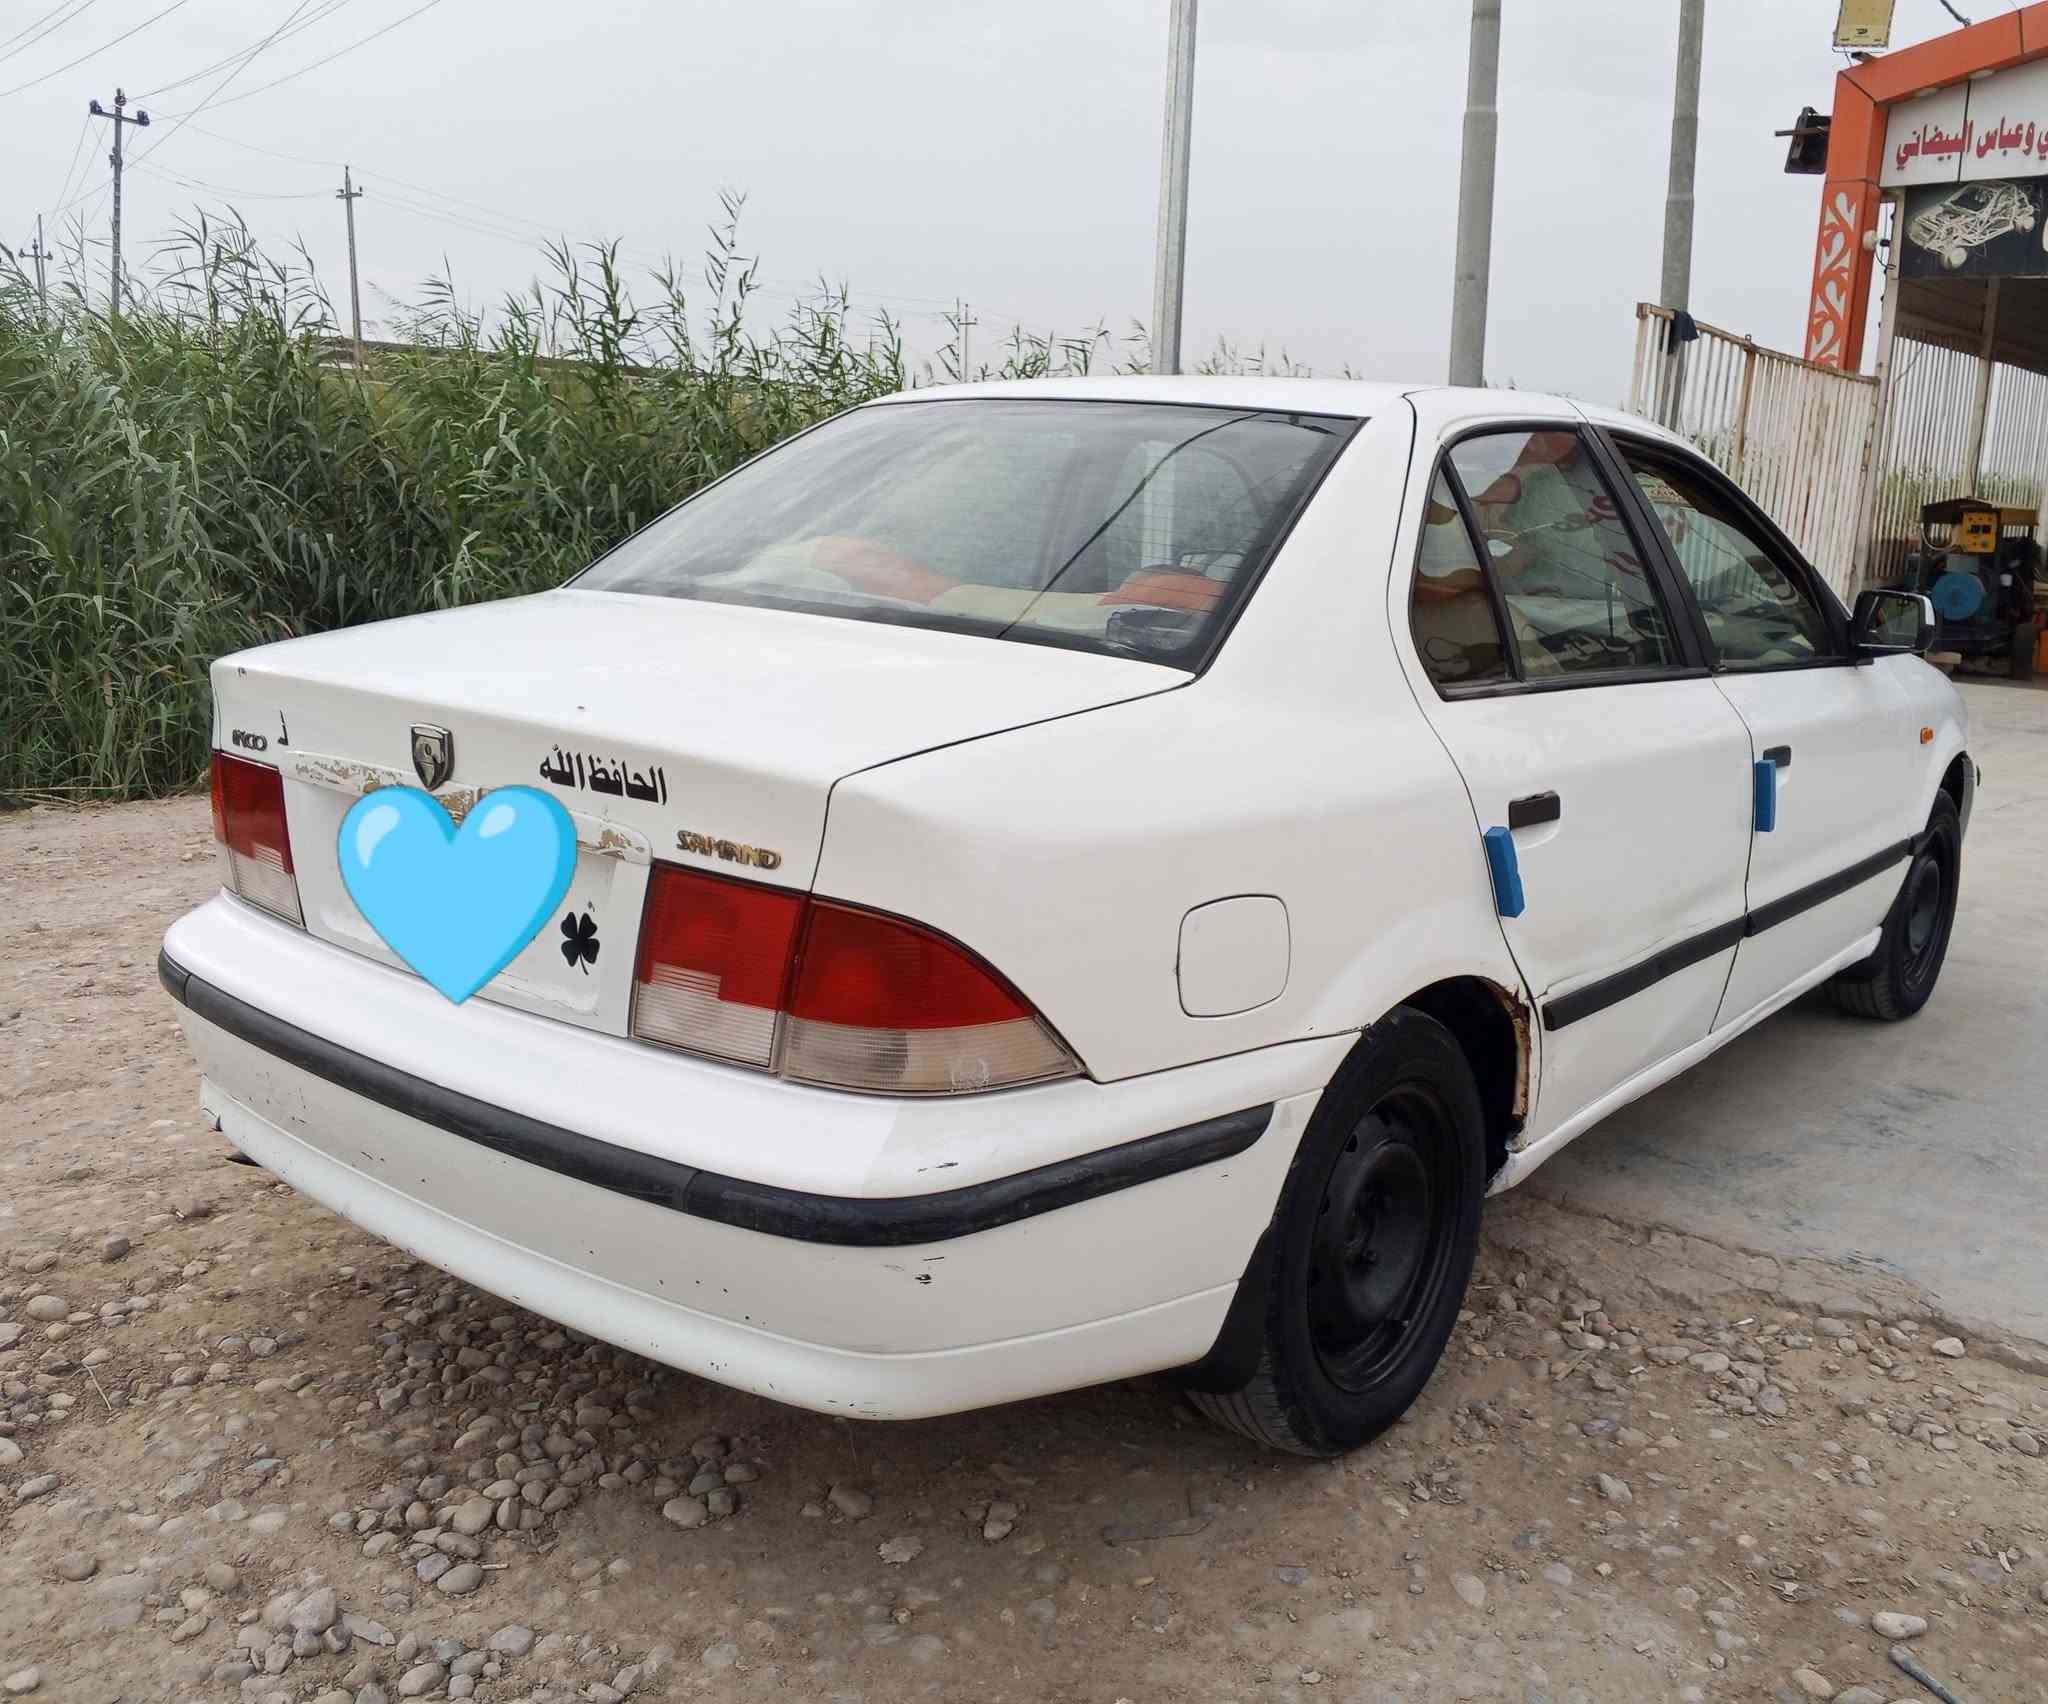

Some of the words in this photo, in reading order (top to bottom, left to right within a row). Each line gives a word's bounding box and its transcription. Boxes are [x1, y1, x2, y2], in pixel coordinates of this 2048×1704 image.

[539, 744, 585, 791] الله
[588, 754, 668, 805] الحافظ
[676, 830, 782, 870] SAMAND
